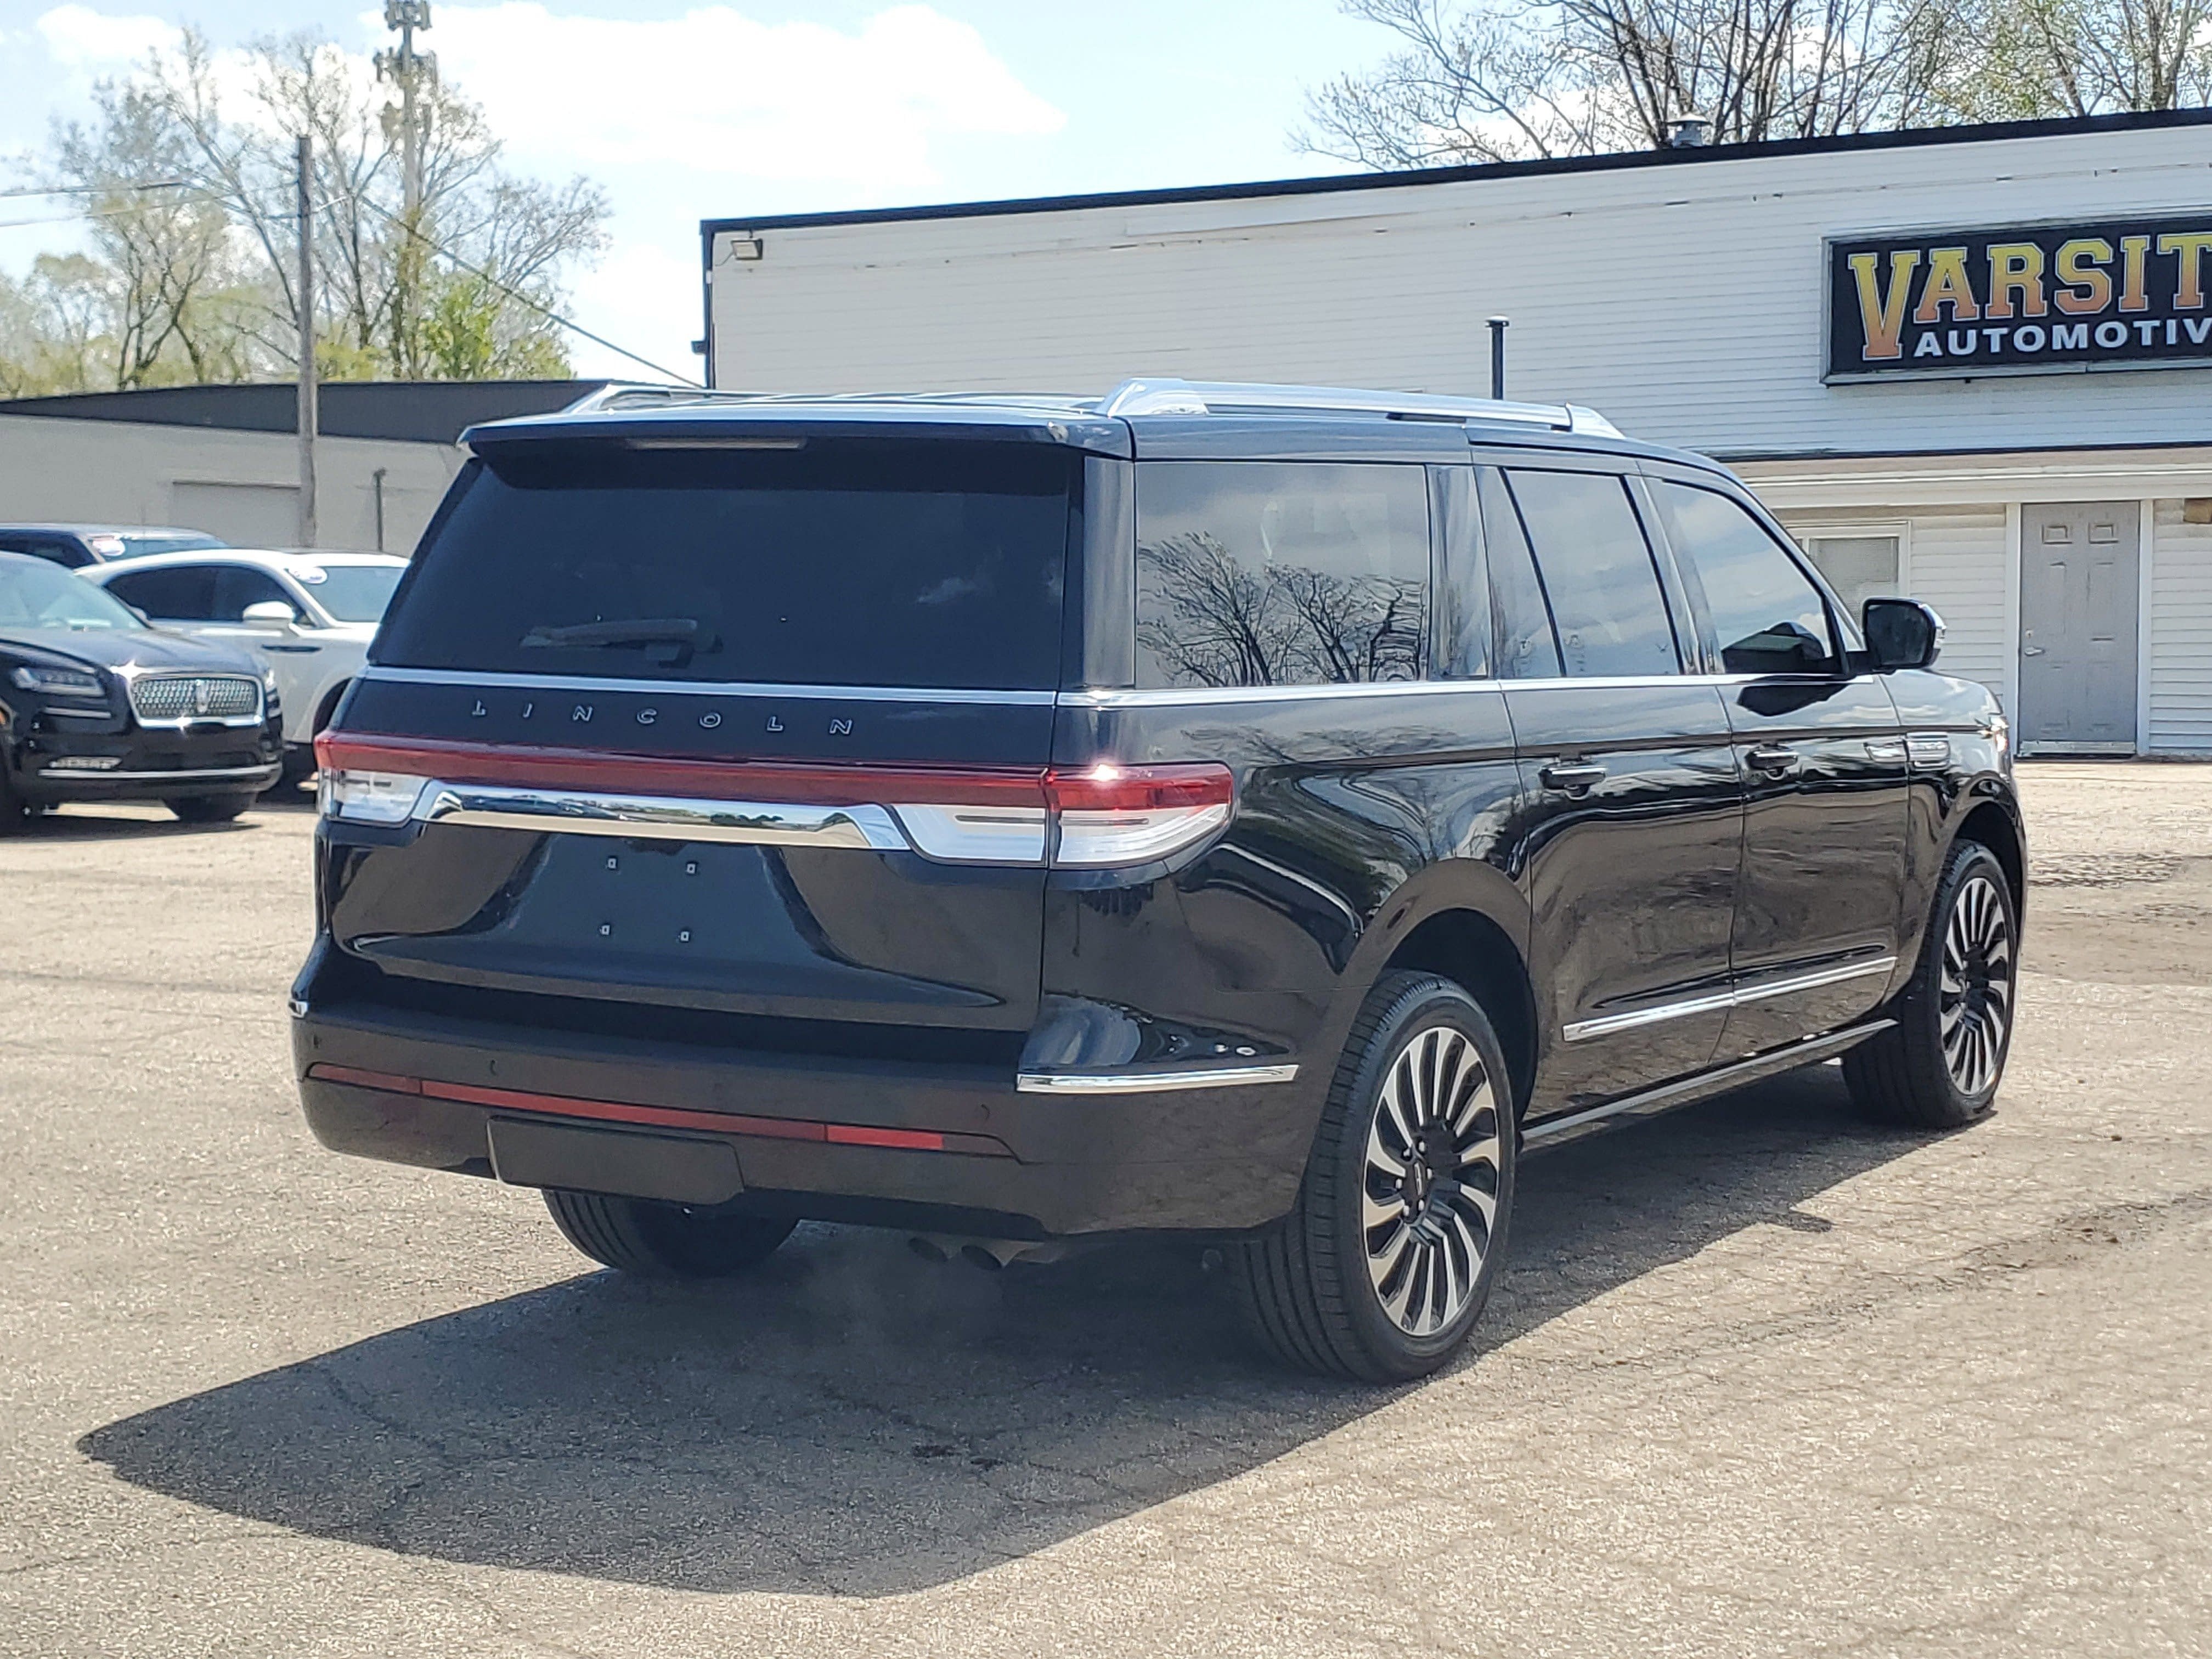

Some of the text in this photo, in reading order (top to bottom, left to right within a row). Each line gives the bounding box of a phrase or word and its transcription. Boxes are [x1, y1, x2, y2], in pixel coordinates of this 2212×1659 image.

[1848, 232, 2212, 360] VARSIT
[1914, 317, 2212, 358] AUTOMOTIV
[471, 699, 853, 735] LINCOLN
